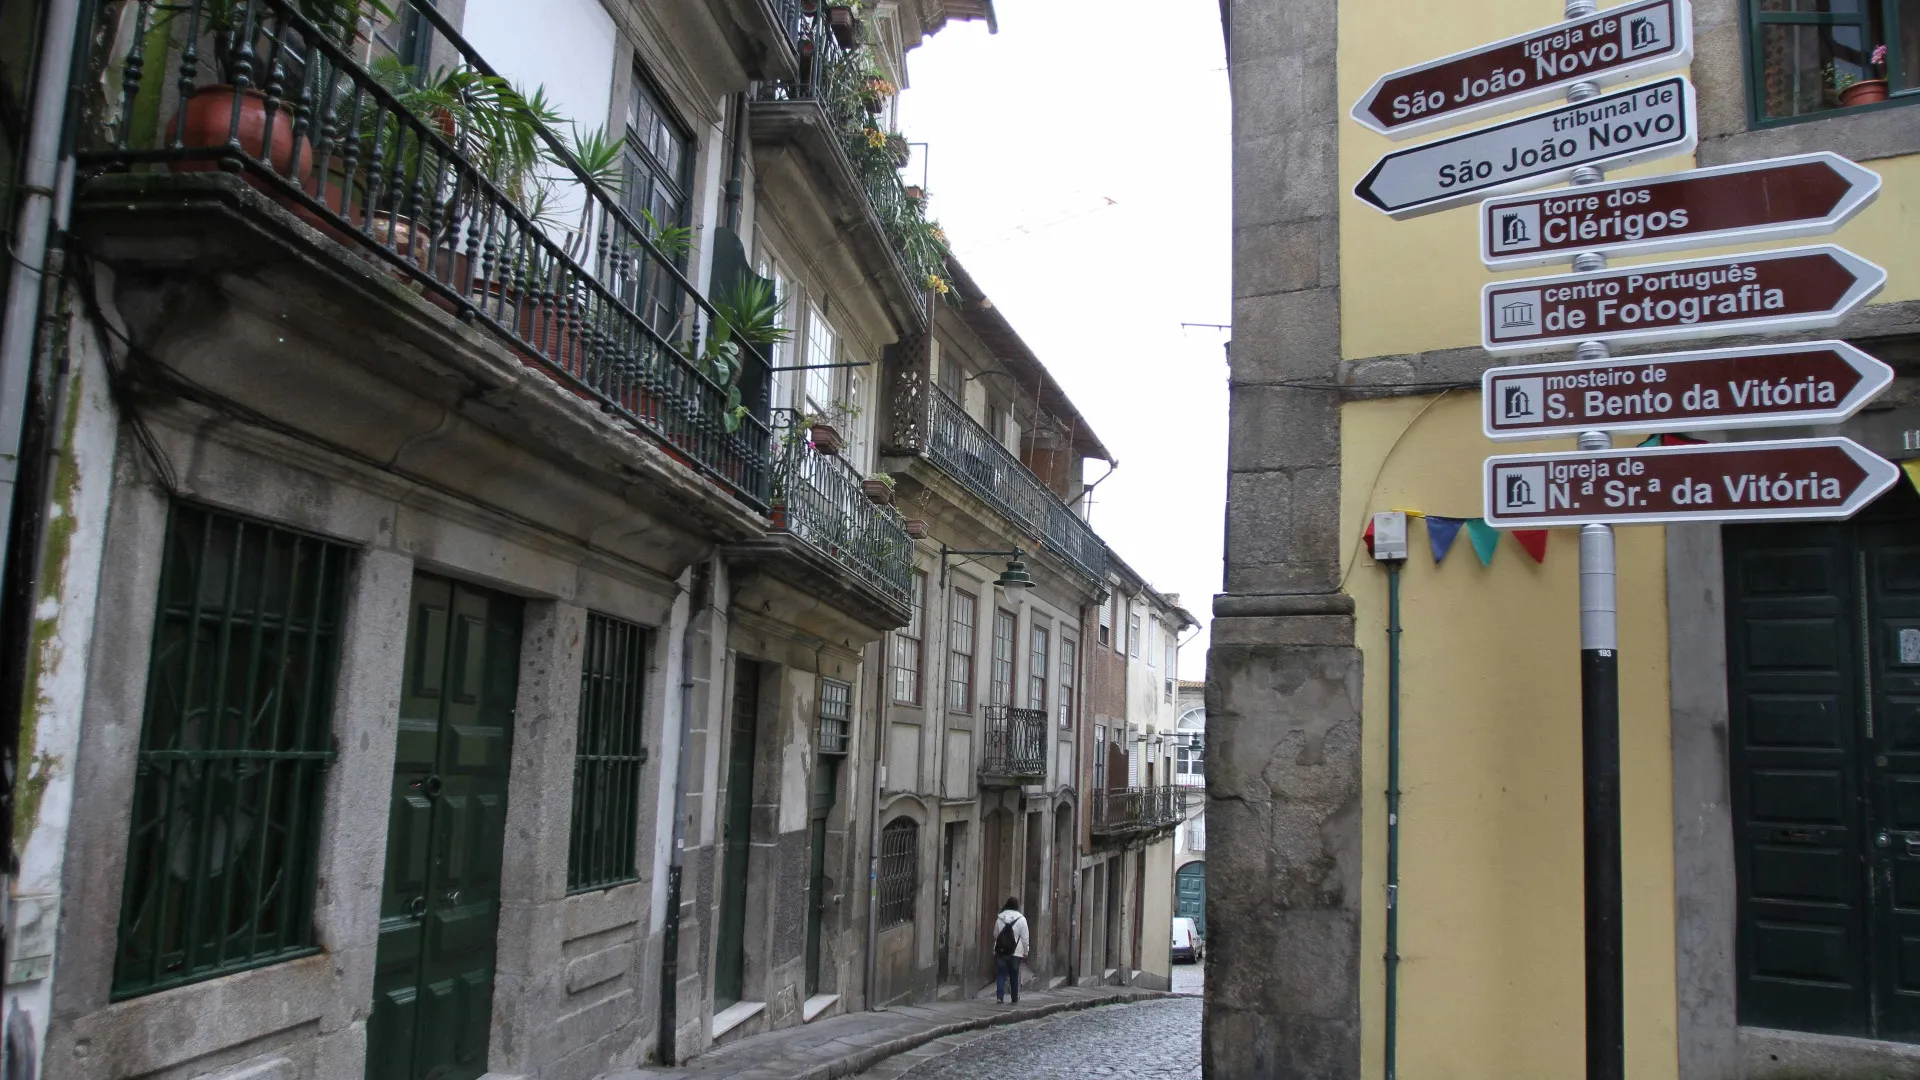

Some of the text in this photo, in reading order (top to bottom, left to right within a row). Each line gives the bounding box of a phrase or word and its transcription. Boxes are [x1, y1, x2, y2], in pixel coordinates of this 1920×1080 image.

[1523, 18, 1618, 60] igreja de
[1392, 42, 1620, 120] São João Novo
[1553, 88, 1674, 133] tribunal de
[1438, 113, 1676, 189] São João Novo
[1544, 187, 1652, 217] torre dos
[1544, 208, 1690, 244] Clérigos
[1544, 264, 1758, 303] centro Português
[1545, 284, 1786, 332] de Fotografia
[1546, 365, 1668, 391] mosteiro de
[1546, 375, 1837, 420] S. Bento da Vitória
[1548, 457, 1645, 482] Igreja de
[1671, 477, 1714, 506] da
[1723, 471, 1842, 503] Vitória
[1598, 649, 1612, 657] 193
